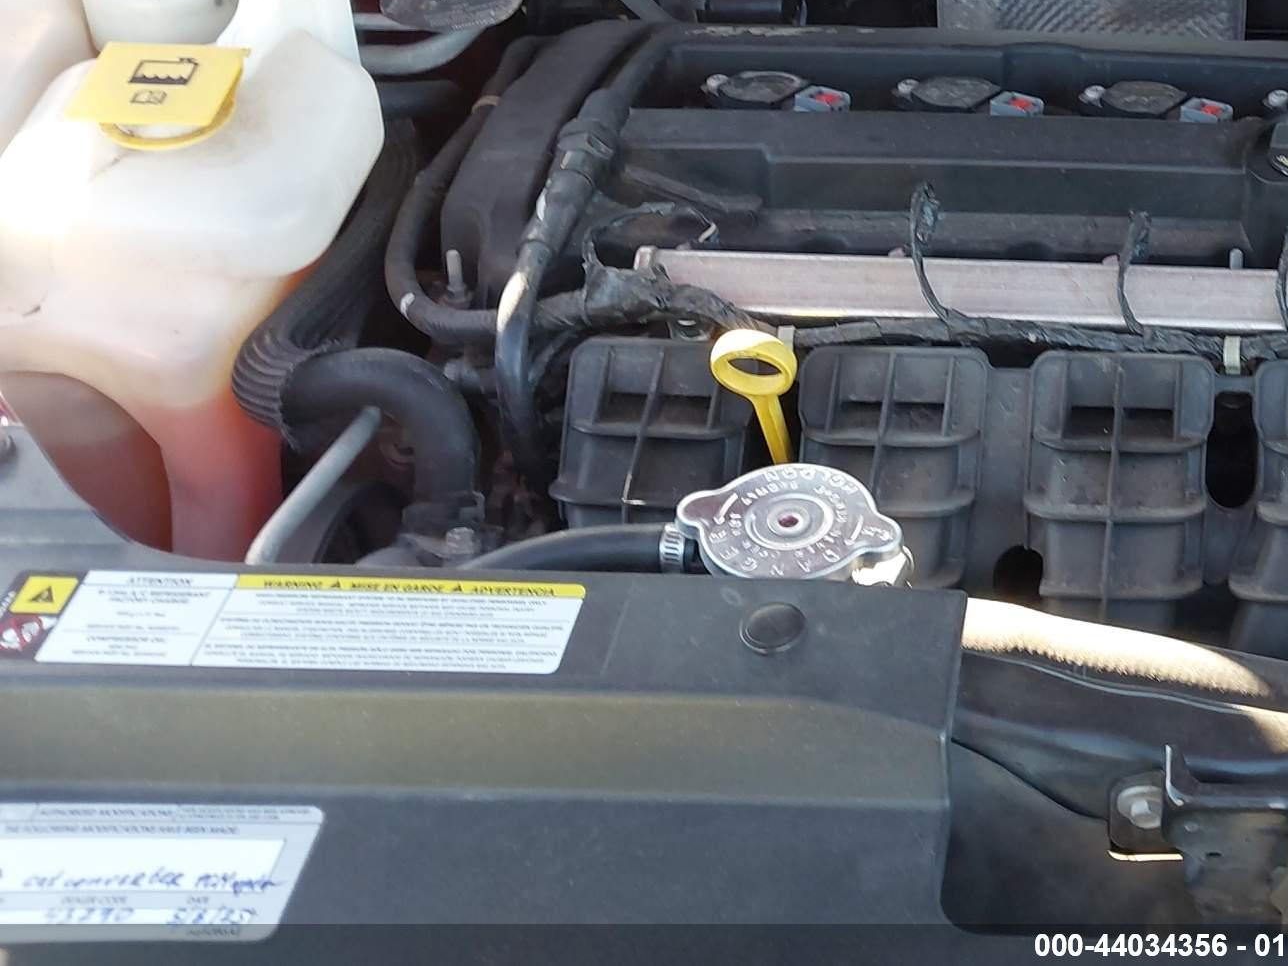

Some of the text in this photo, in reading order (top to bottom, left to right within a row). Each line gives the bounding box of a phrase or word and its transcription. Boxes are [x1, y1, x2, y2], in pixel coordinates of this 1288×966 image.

[263, 579, 556, 597] WARNING MISE EN GARDE ADVERTENCIA
